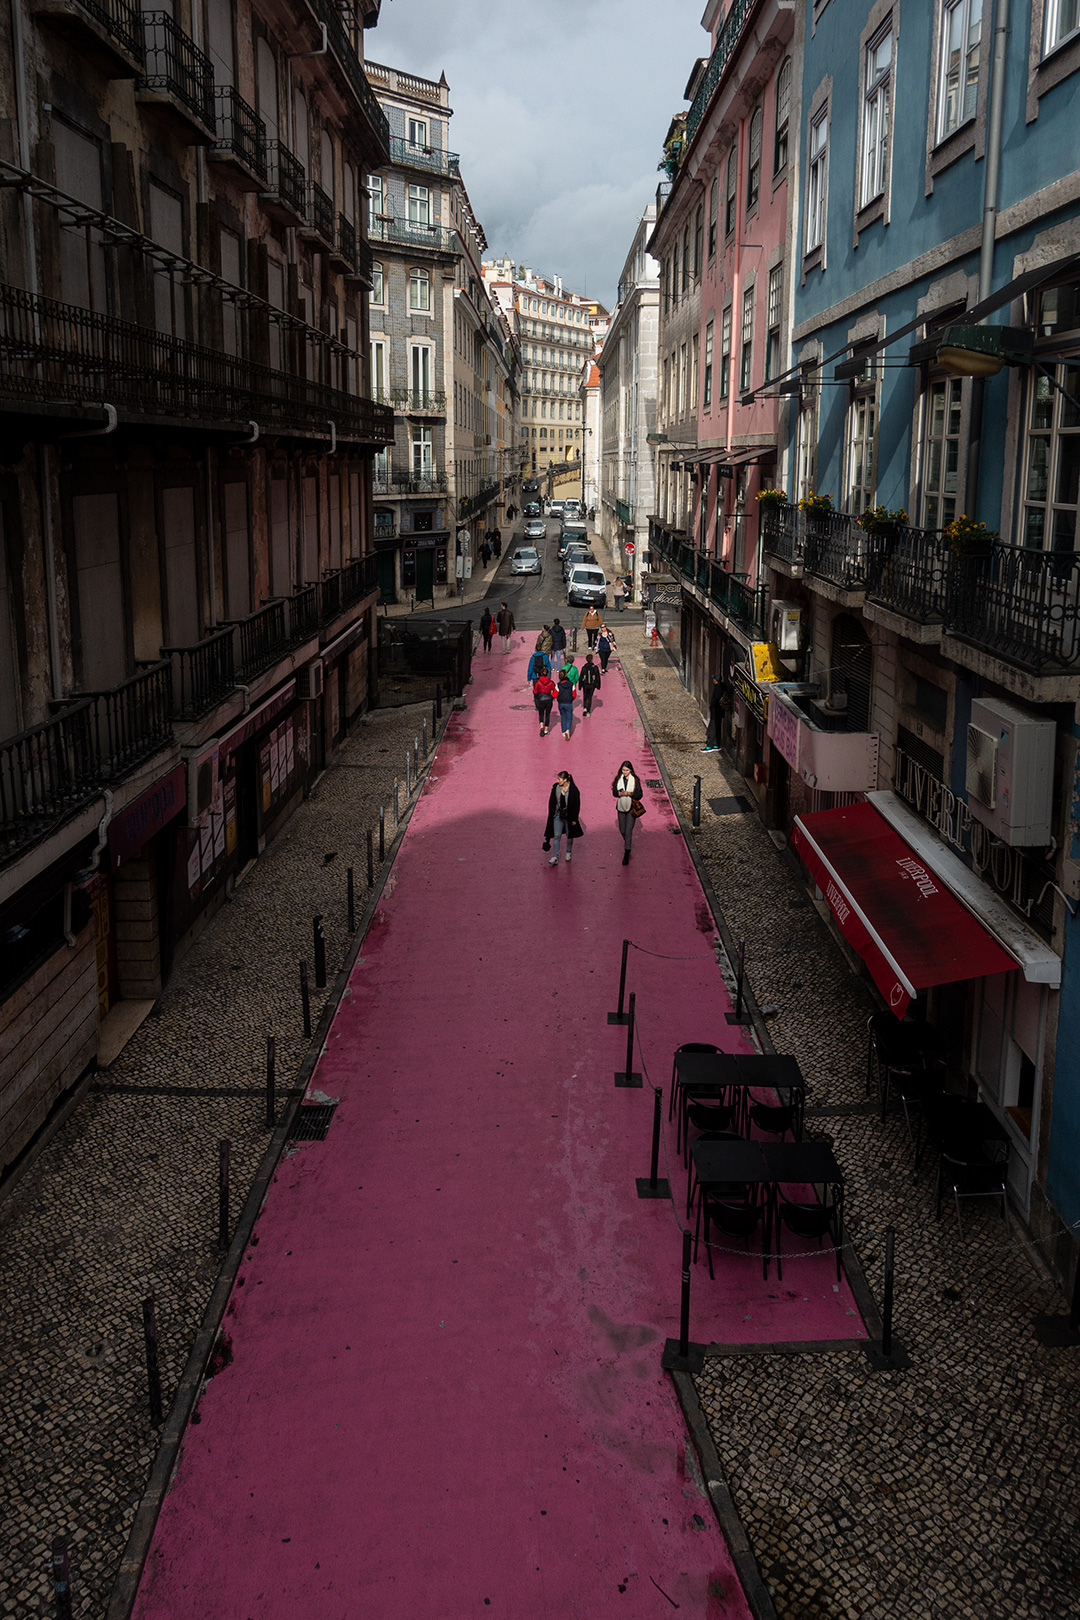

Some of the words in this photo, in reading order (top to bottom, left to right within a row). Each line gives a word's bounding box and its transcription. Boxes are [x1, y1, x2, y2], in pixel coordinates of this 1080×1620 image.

[656, 584, 682, 593] bar
[126, 780, 174, 843] europa
[895, 747, 1034, 917] LIVERPOOL
[896, 857, 939, 899] LIVERPOOL
[826, 880, 850, 925] LIVERPOOL
